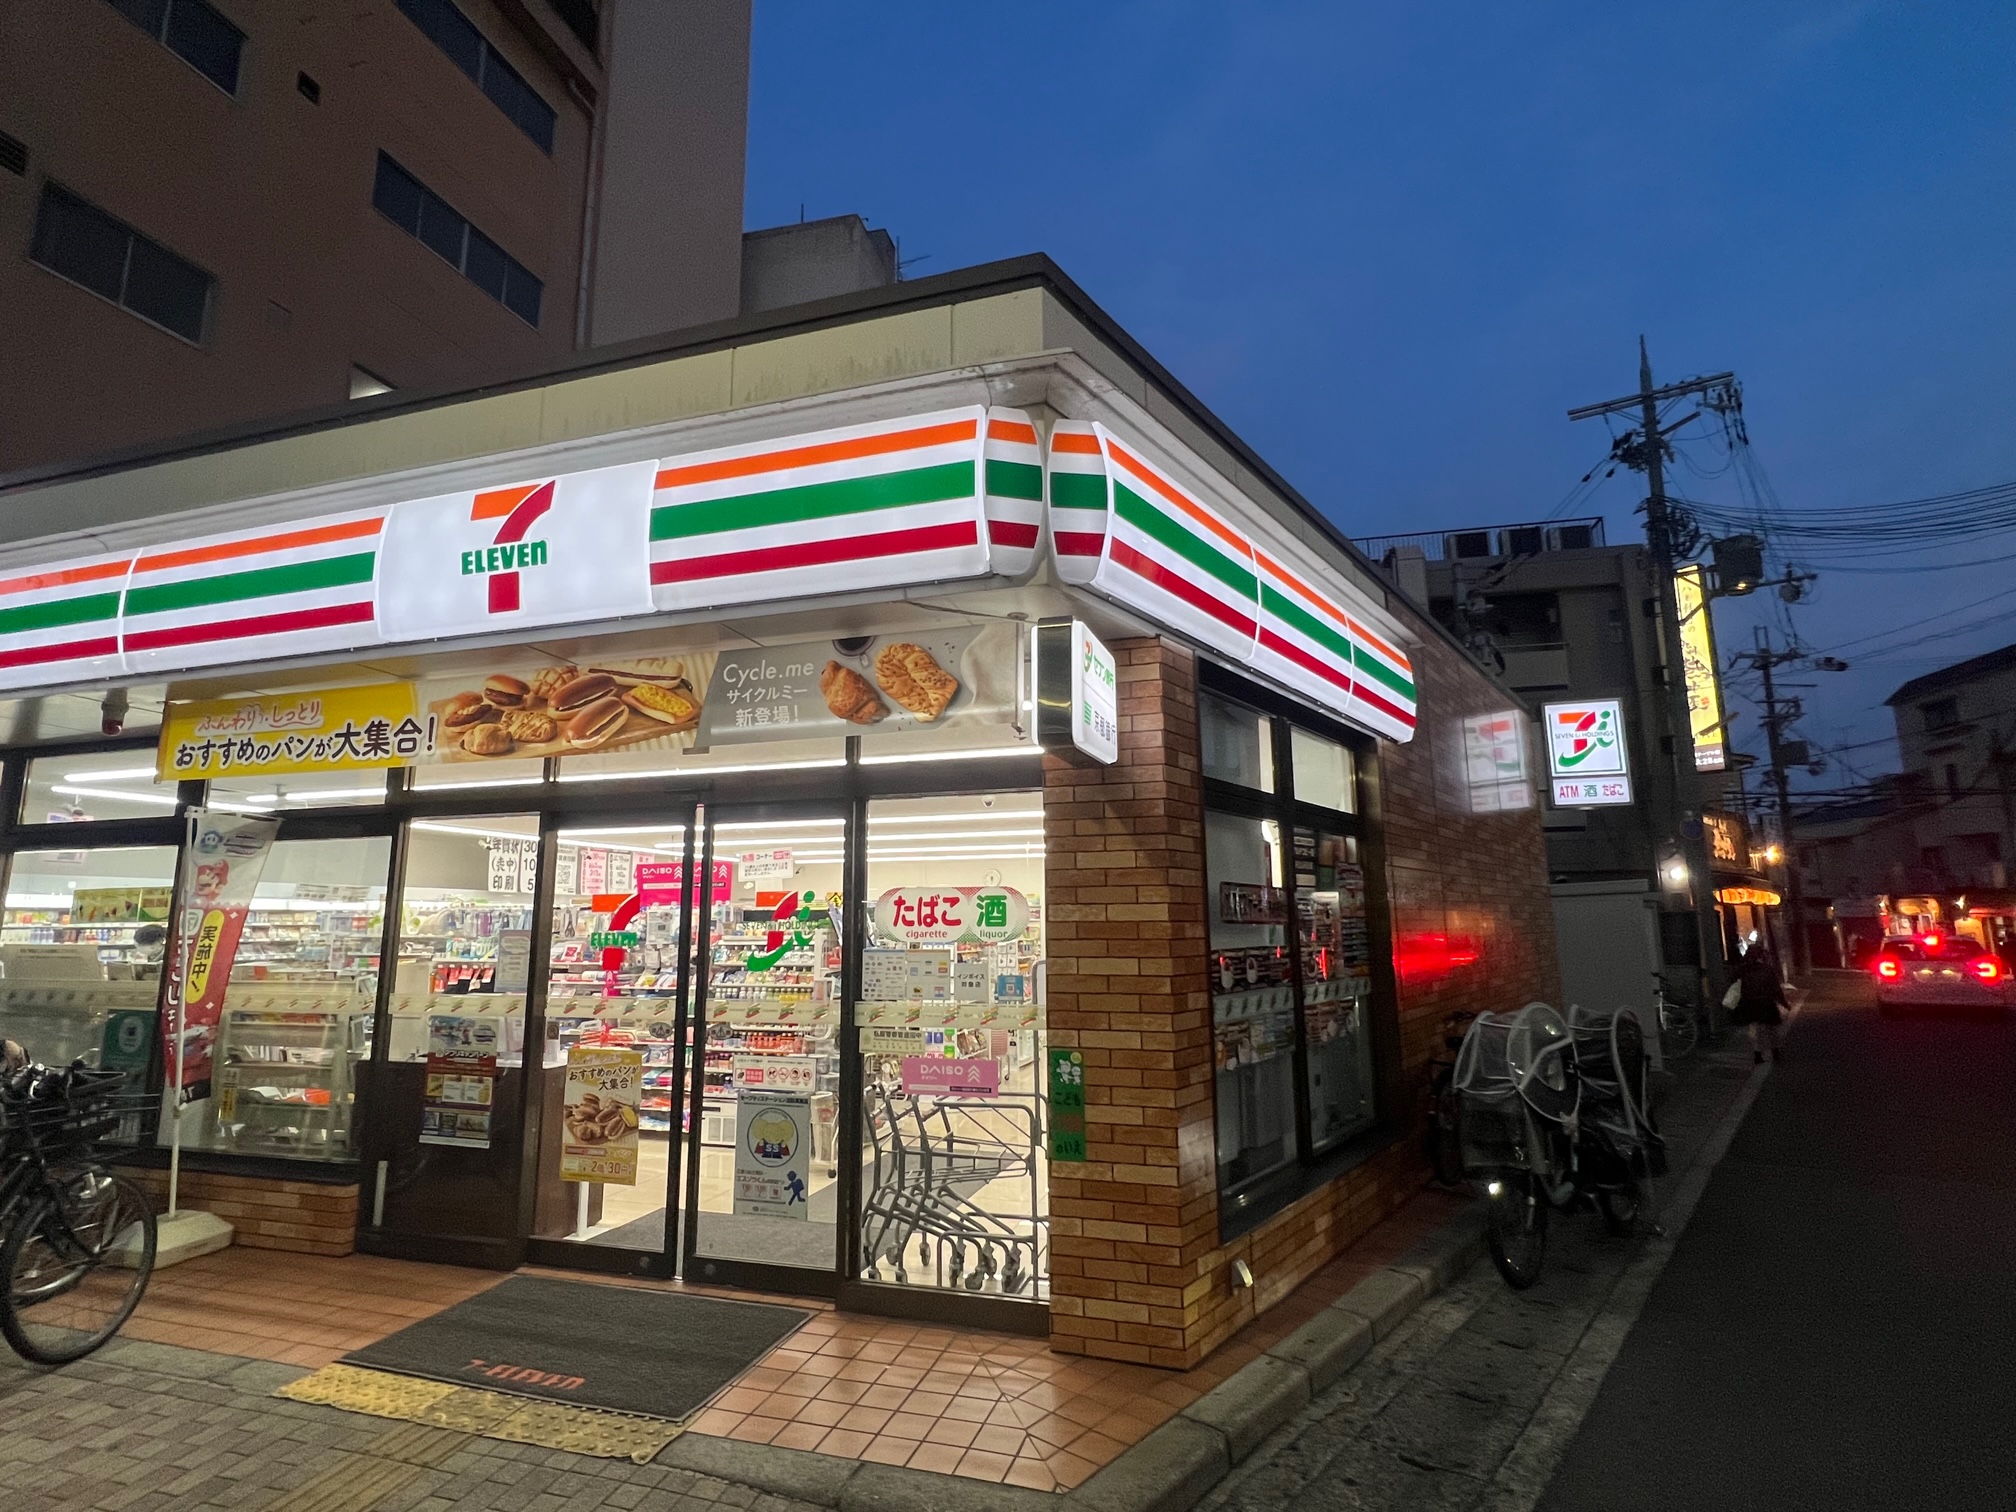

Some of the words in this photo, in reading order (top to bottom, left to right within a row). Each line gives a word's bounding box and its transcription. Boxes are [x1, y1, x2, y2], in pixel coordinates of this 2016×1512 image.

[723, 660, 815, 688] Cycle.me
[726, 685, 808, 704] サイクルミー
[1583, 730, 1615, 738] HOLDINGS
[1559, 785, 1579, 798] ATM
[1583, 785, 1598, 797] 酒
[1602, 784, 1625, 796] たばこ
[492, 838, 519, 854] 年賀状
[493, 875, 514, 891] 印刷
[893, 893, 962, 928] たばこ
[976, 894, 1008, 928] 酒
[905, 930, 948, 940] cigarette
[979, 929, 1009, 939] liquor
[956, 973, 986, 981] インボイス
[569, 1065, 640, 1081] おすすめのパンが
[598, 1076, 634, 1091] 大集合!
[765, 1144, 780, 1153] SS
